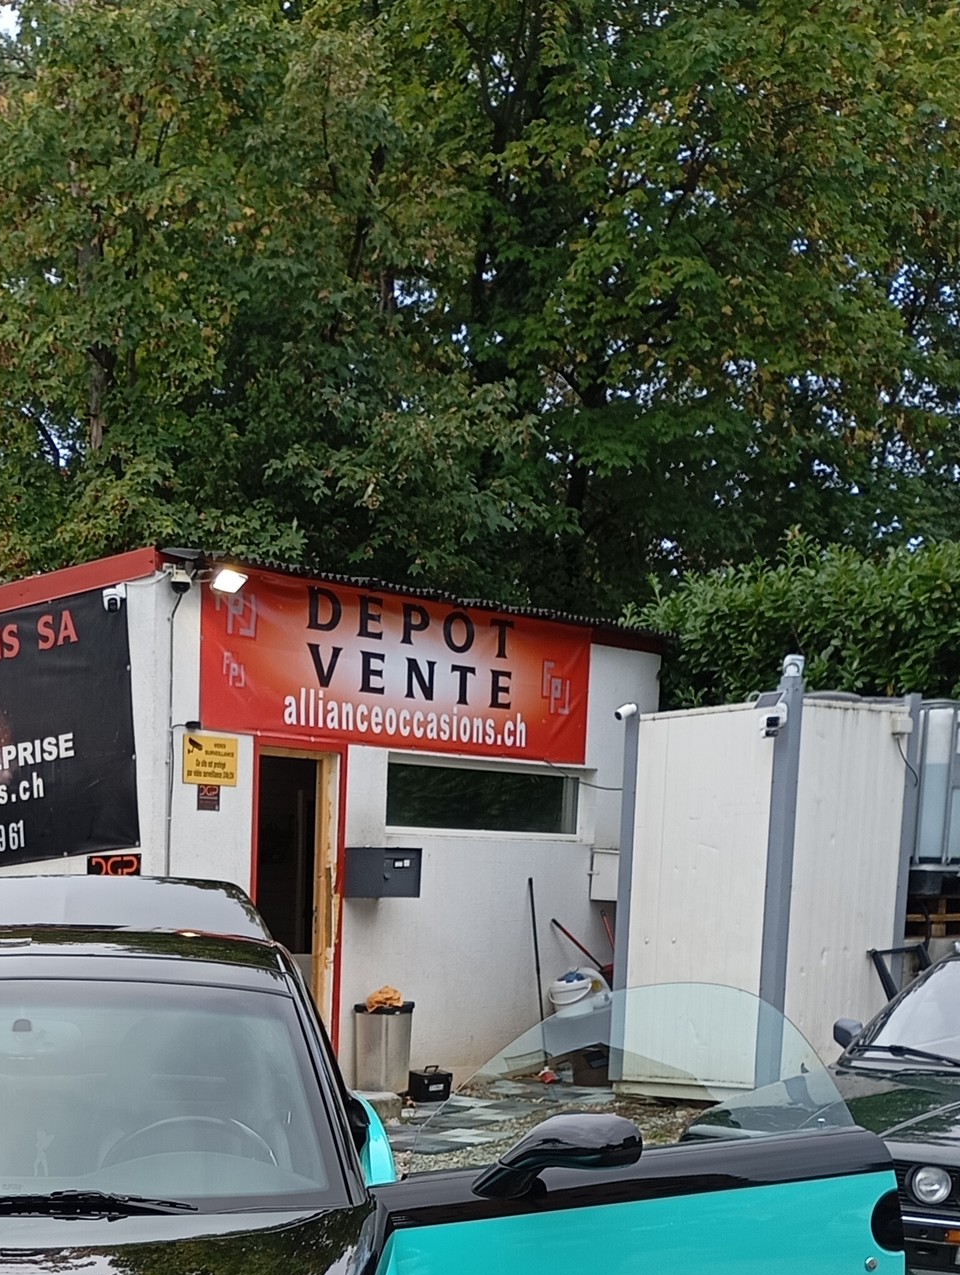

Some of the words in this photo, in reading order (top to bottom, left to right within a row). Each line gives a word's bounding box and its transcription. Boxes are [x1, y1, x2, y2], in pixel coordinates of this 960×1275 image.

[36, 609, 79, 650] SA
[306, 641, 513, 710] VENTE
[283, 687, 527, 748] allianceoccasions.ch
[9, 819, 25, 850] 61
